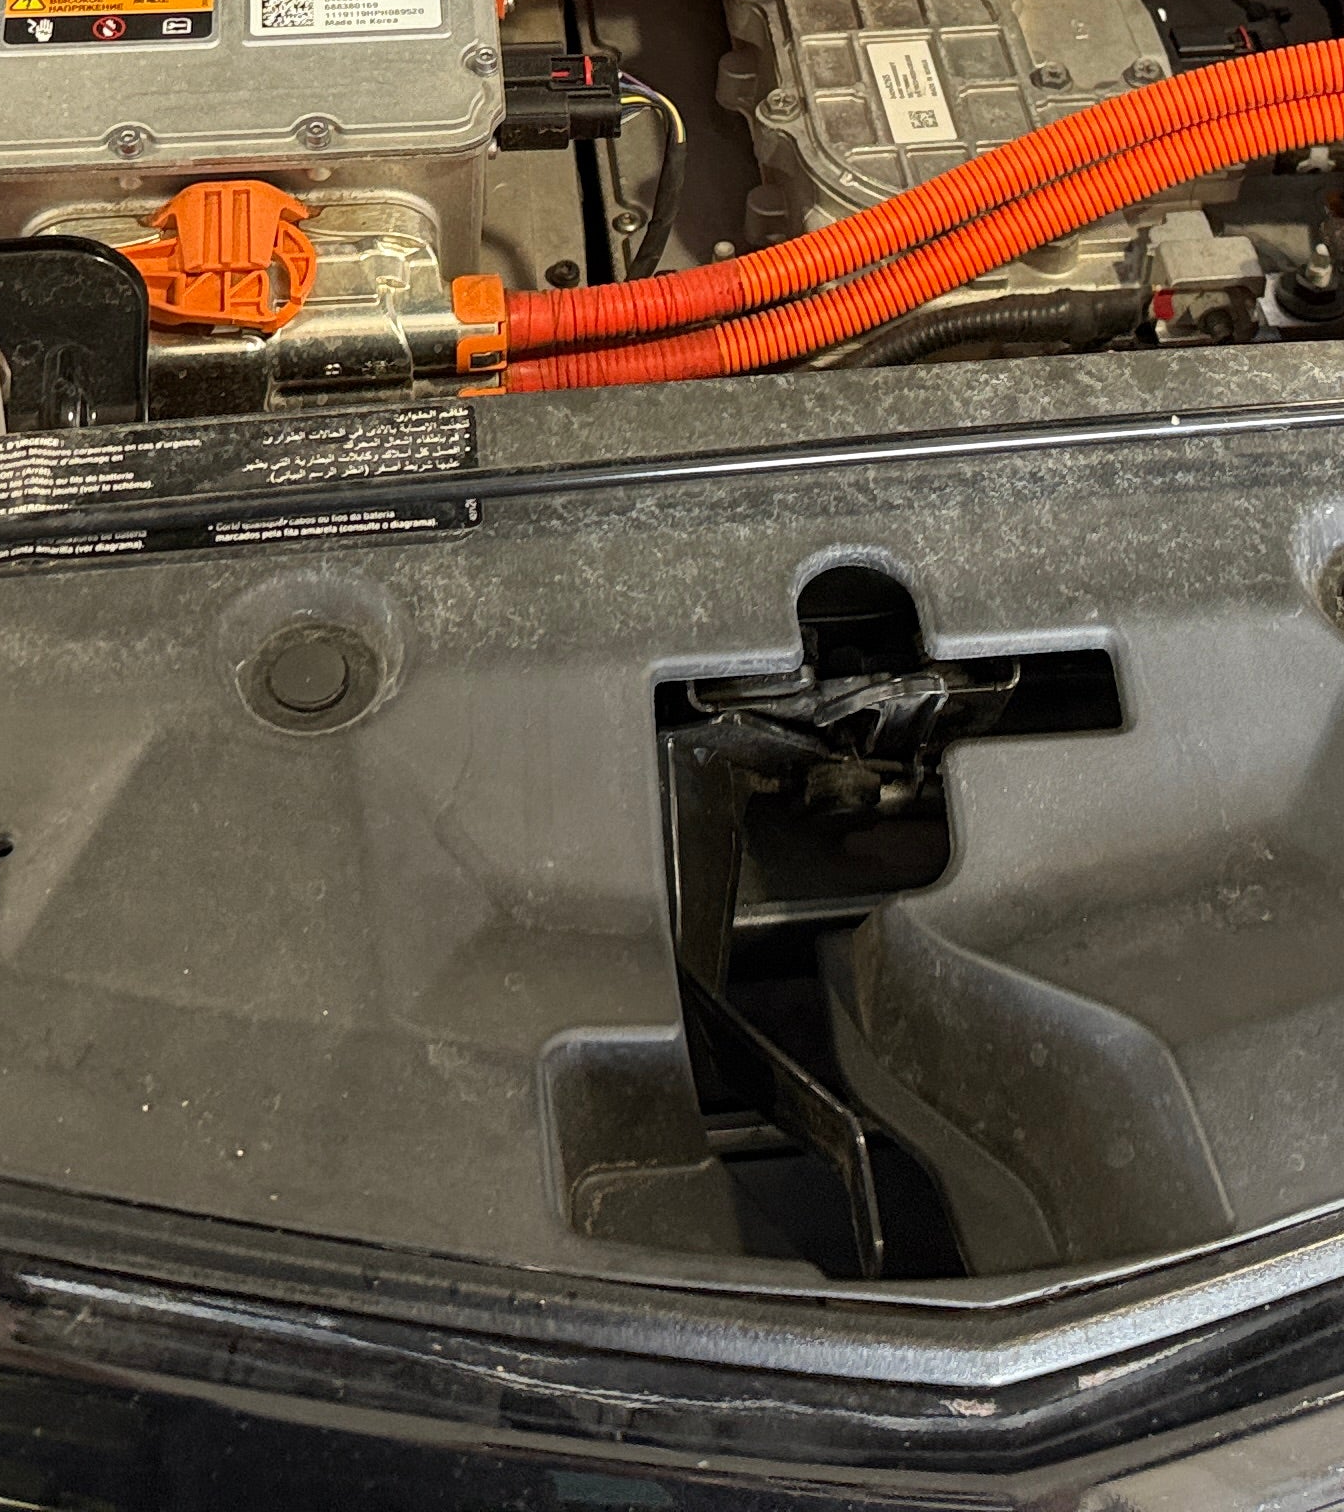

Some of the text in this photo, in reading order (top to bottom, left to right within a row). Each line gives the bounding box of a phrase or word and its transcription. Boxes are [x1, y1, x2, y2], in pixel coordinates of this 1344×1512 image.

[324, 18, 347, 26] Made
[369, 16, 399, 25] Korea
[363, 509, 395, 520] bateria
[214, 531, 260, 543] marcados
[390, 518, 439, 530] diagrama).
